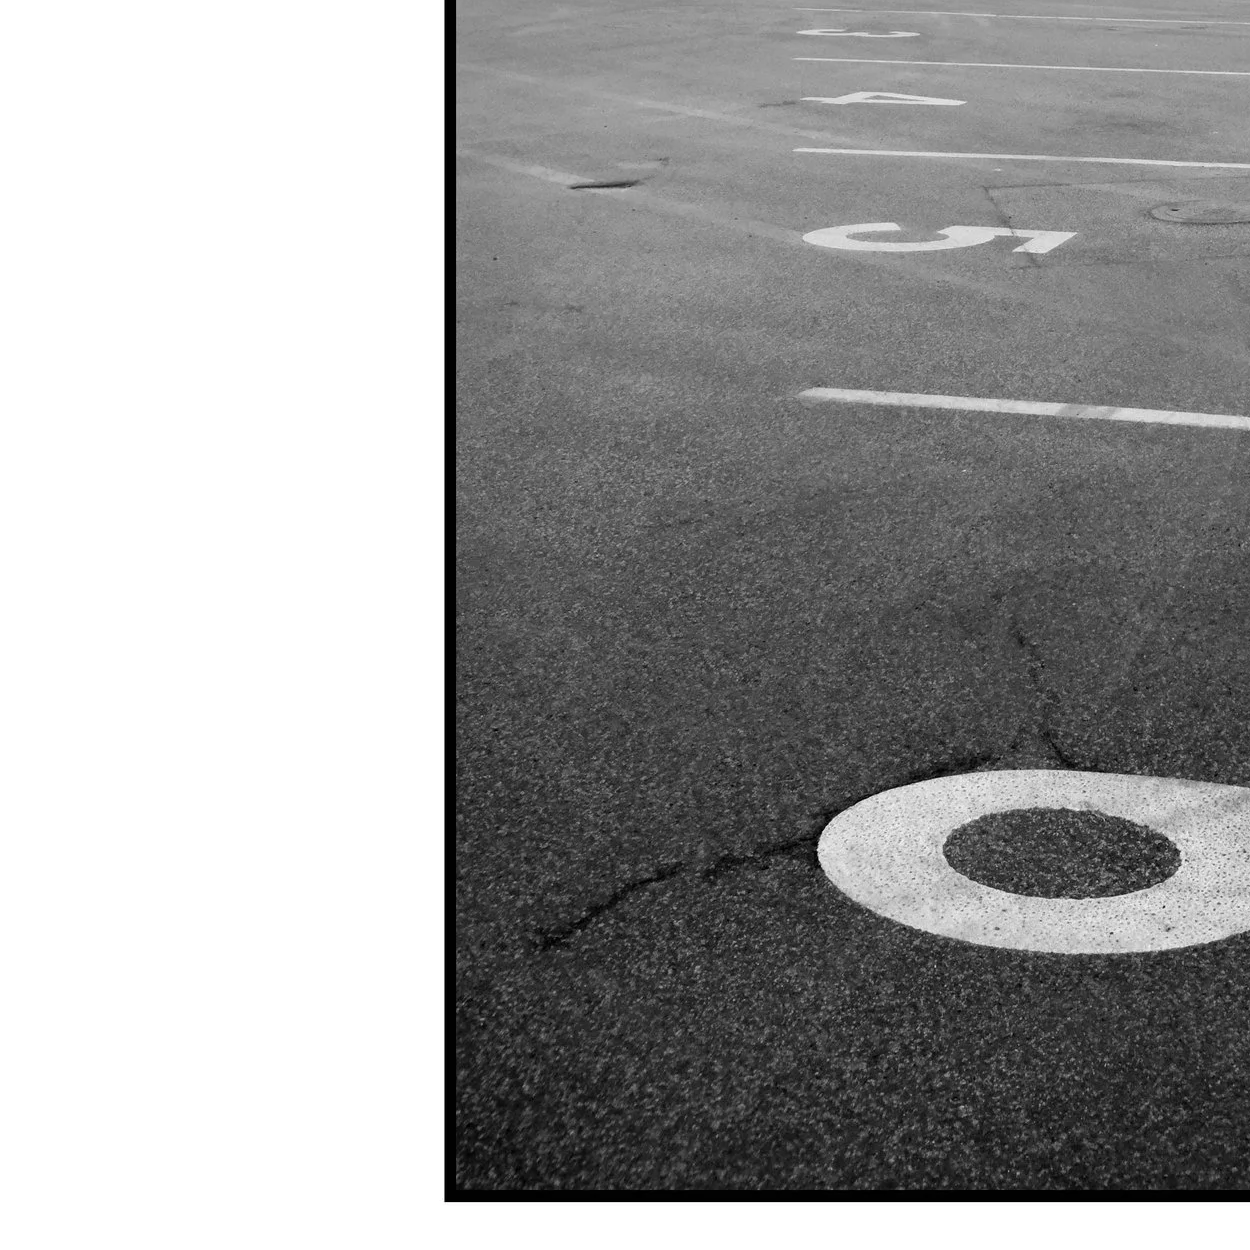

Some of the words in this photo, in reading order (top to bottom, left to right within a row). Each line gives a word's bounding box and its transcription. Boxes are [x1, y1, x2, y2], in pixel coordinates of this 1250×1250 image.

[796, 28, 921, 38] 3
[800, 91, 968, 106] 4
[802, 222, 1078, 254] 5
